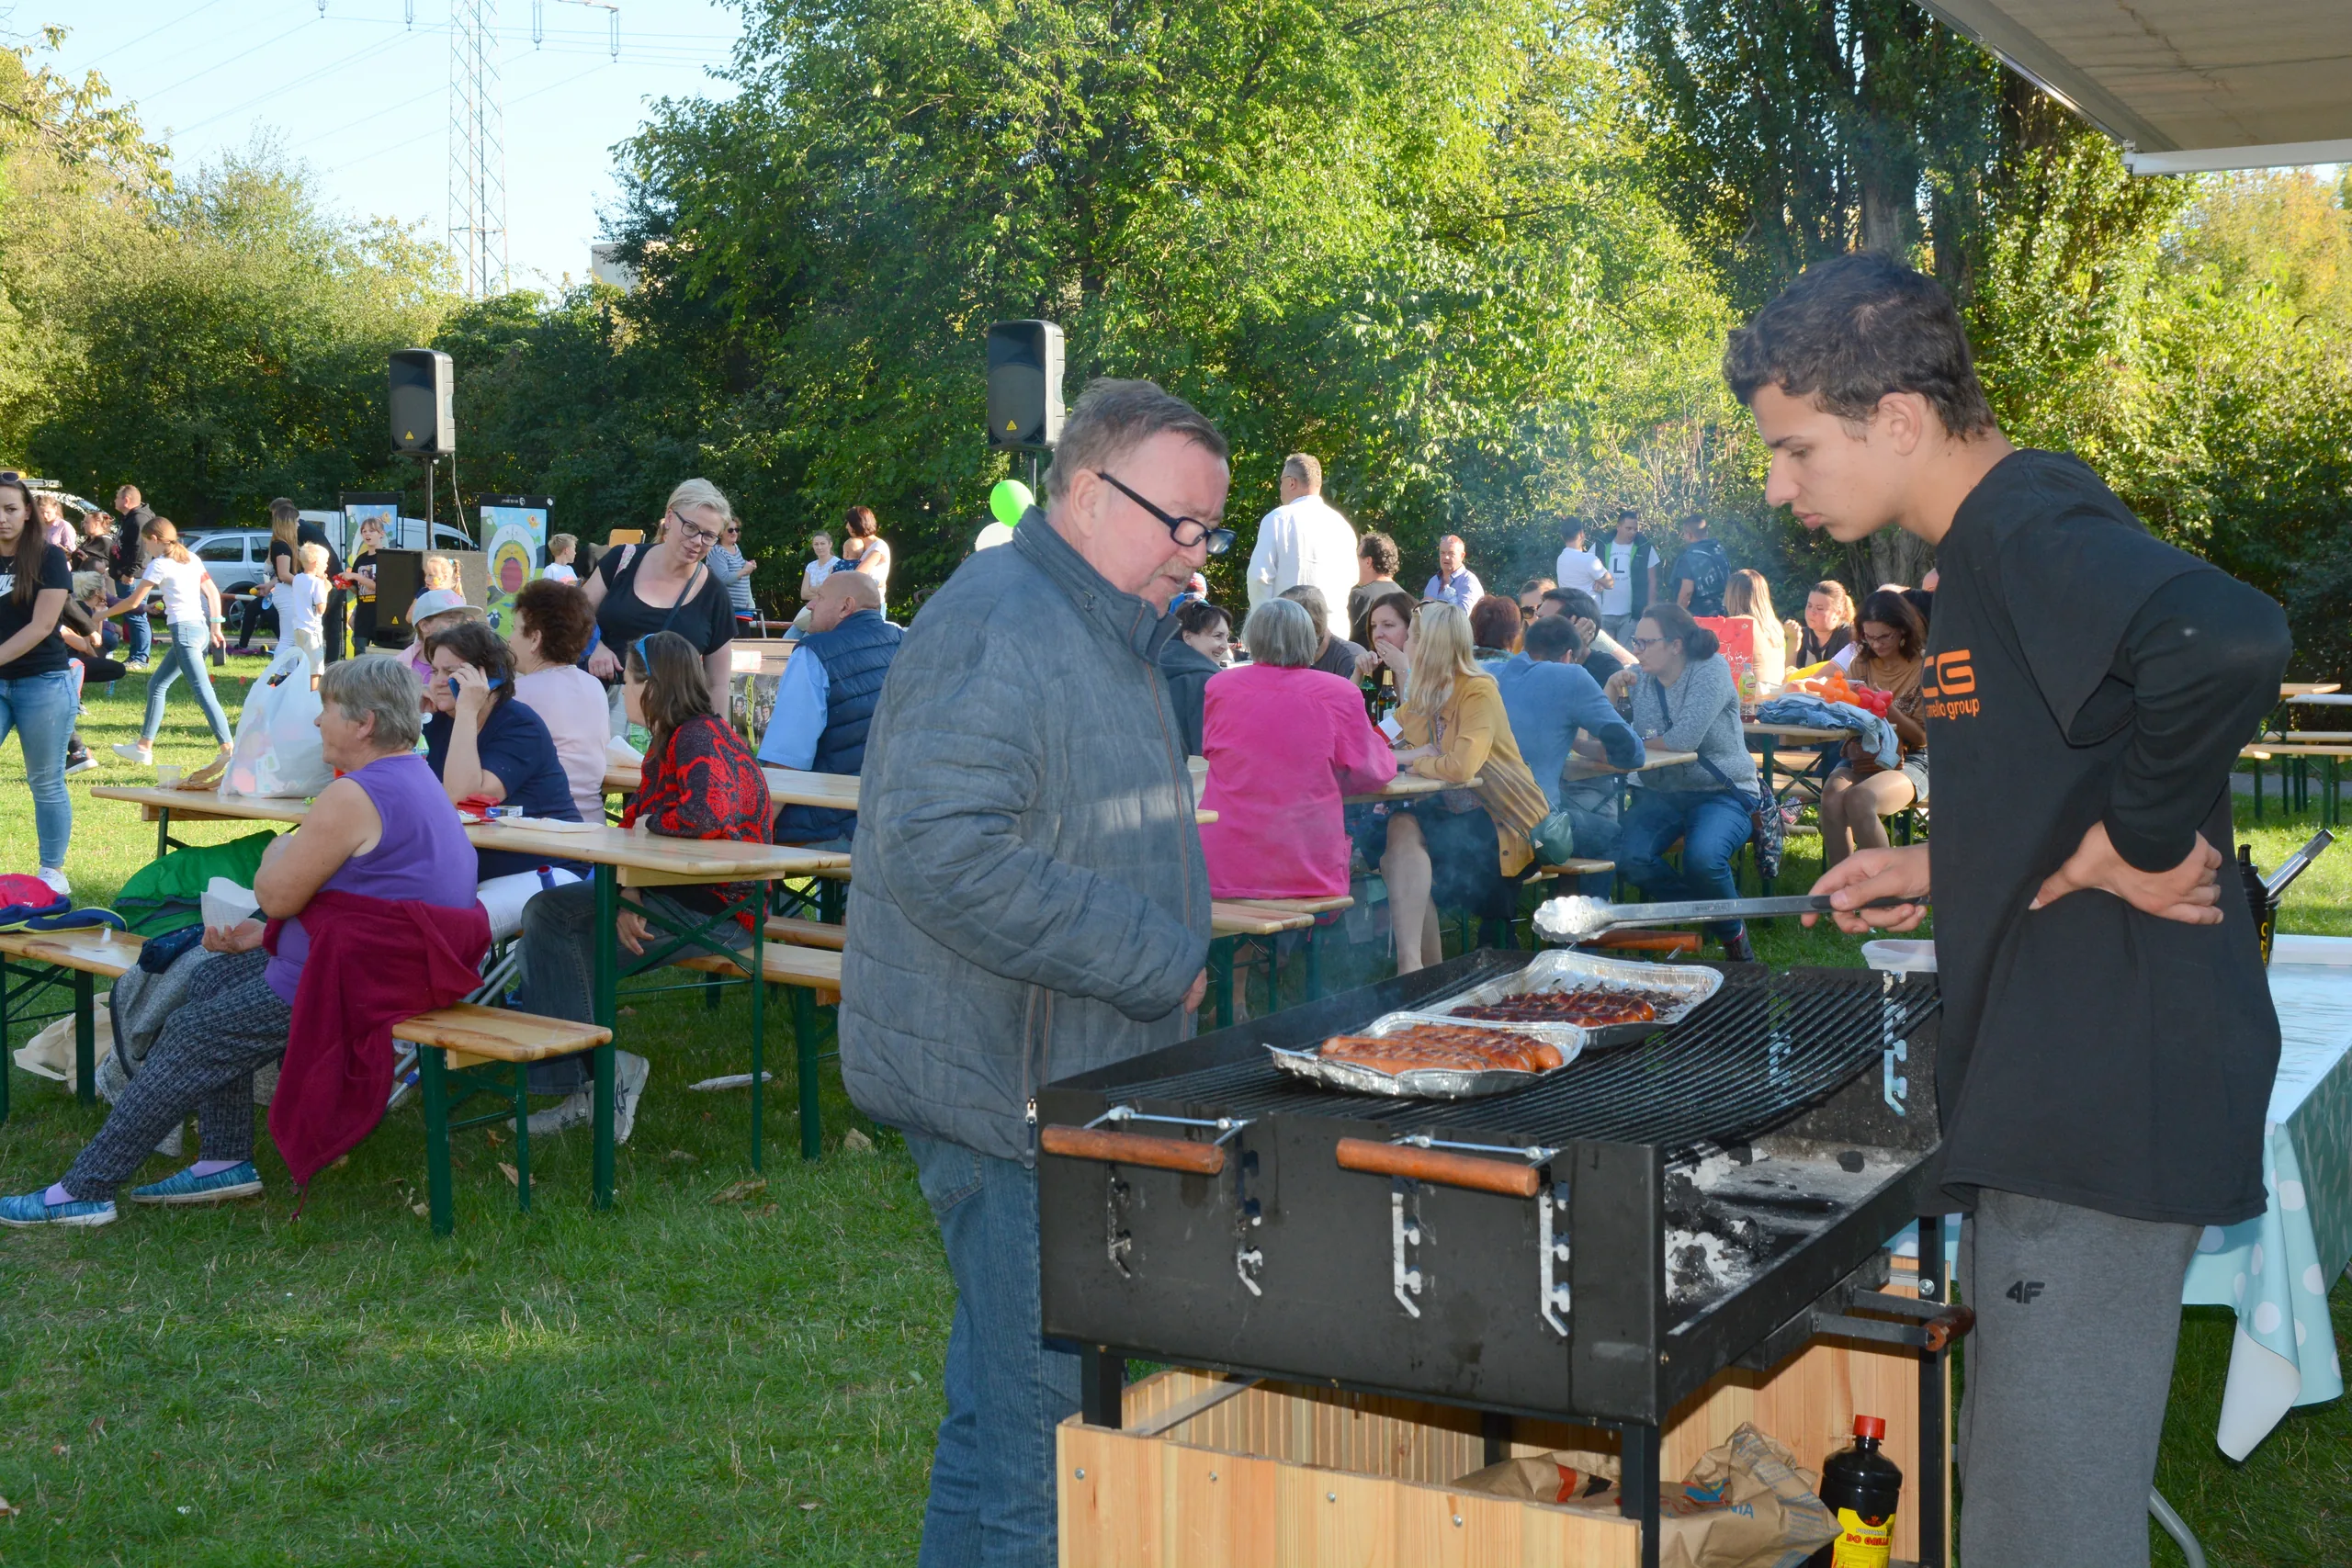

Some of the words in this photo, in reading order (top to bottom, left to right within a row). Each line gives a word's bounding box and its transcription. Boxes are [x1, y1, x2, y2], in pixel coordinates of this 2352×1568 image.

[1613, 558, 1625, 574] L
[1947, 697, 1980, 720] group
[2006, 1280, 2046, 1304] 4F
[1846, 1532, 1862, 1544] DO
